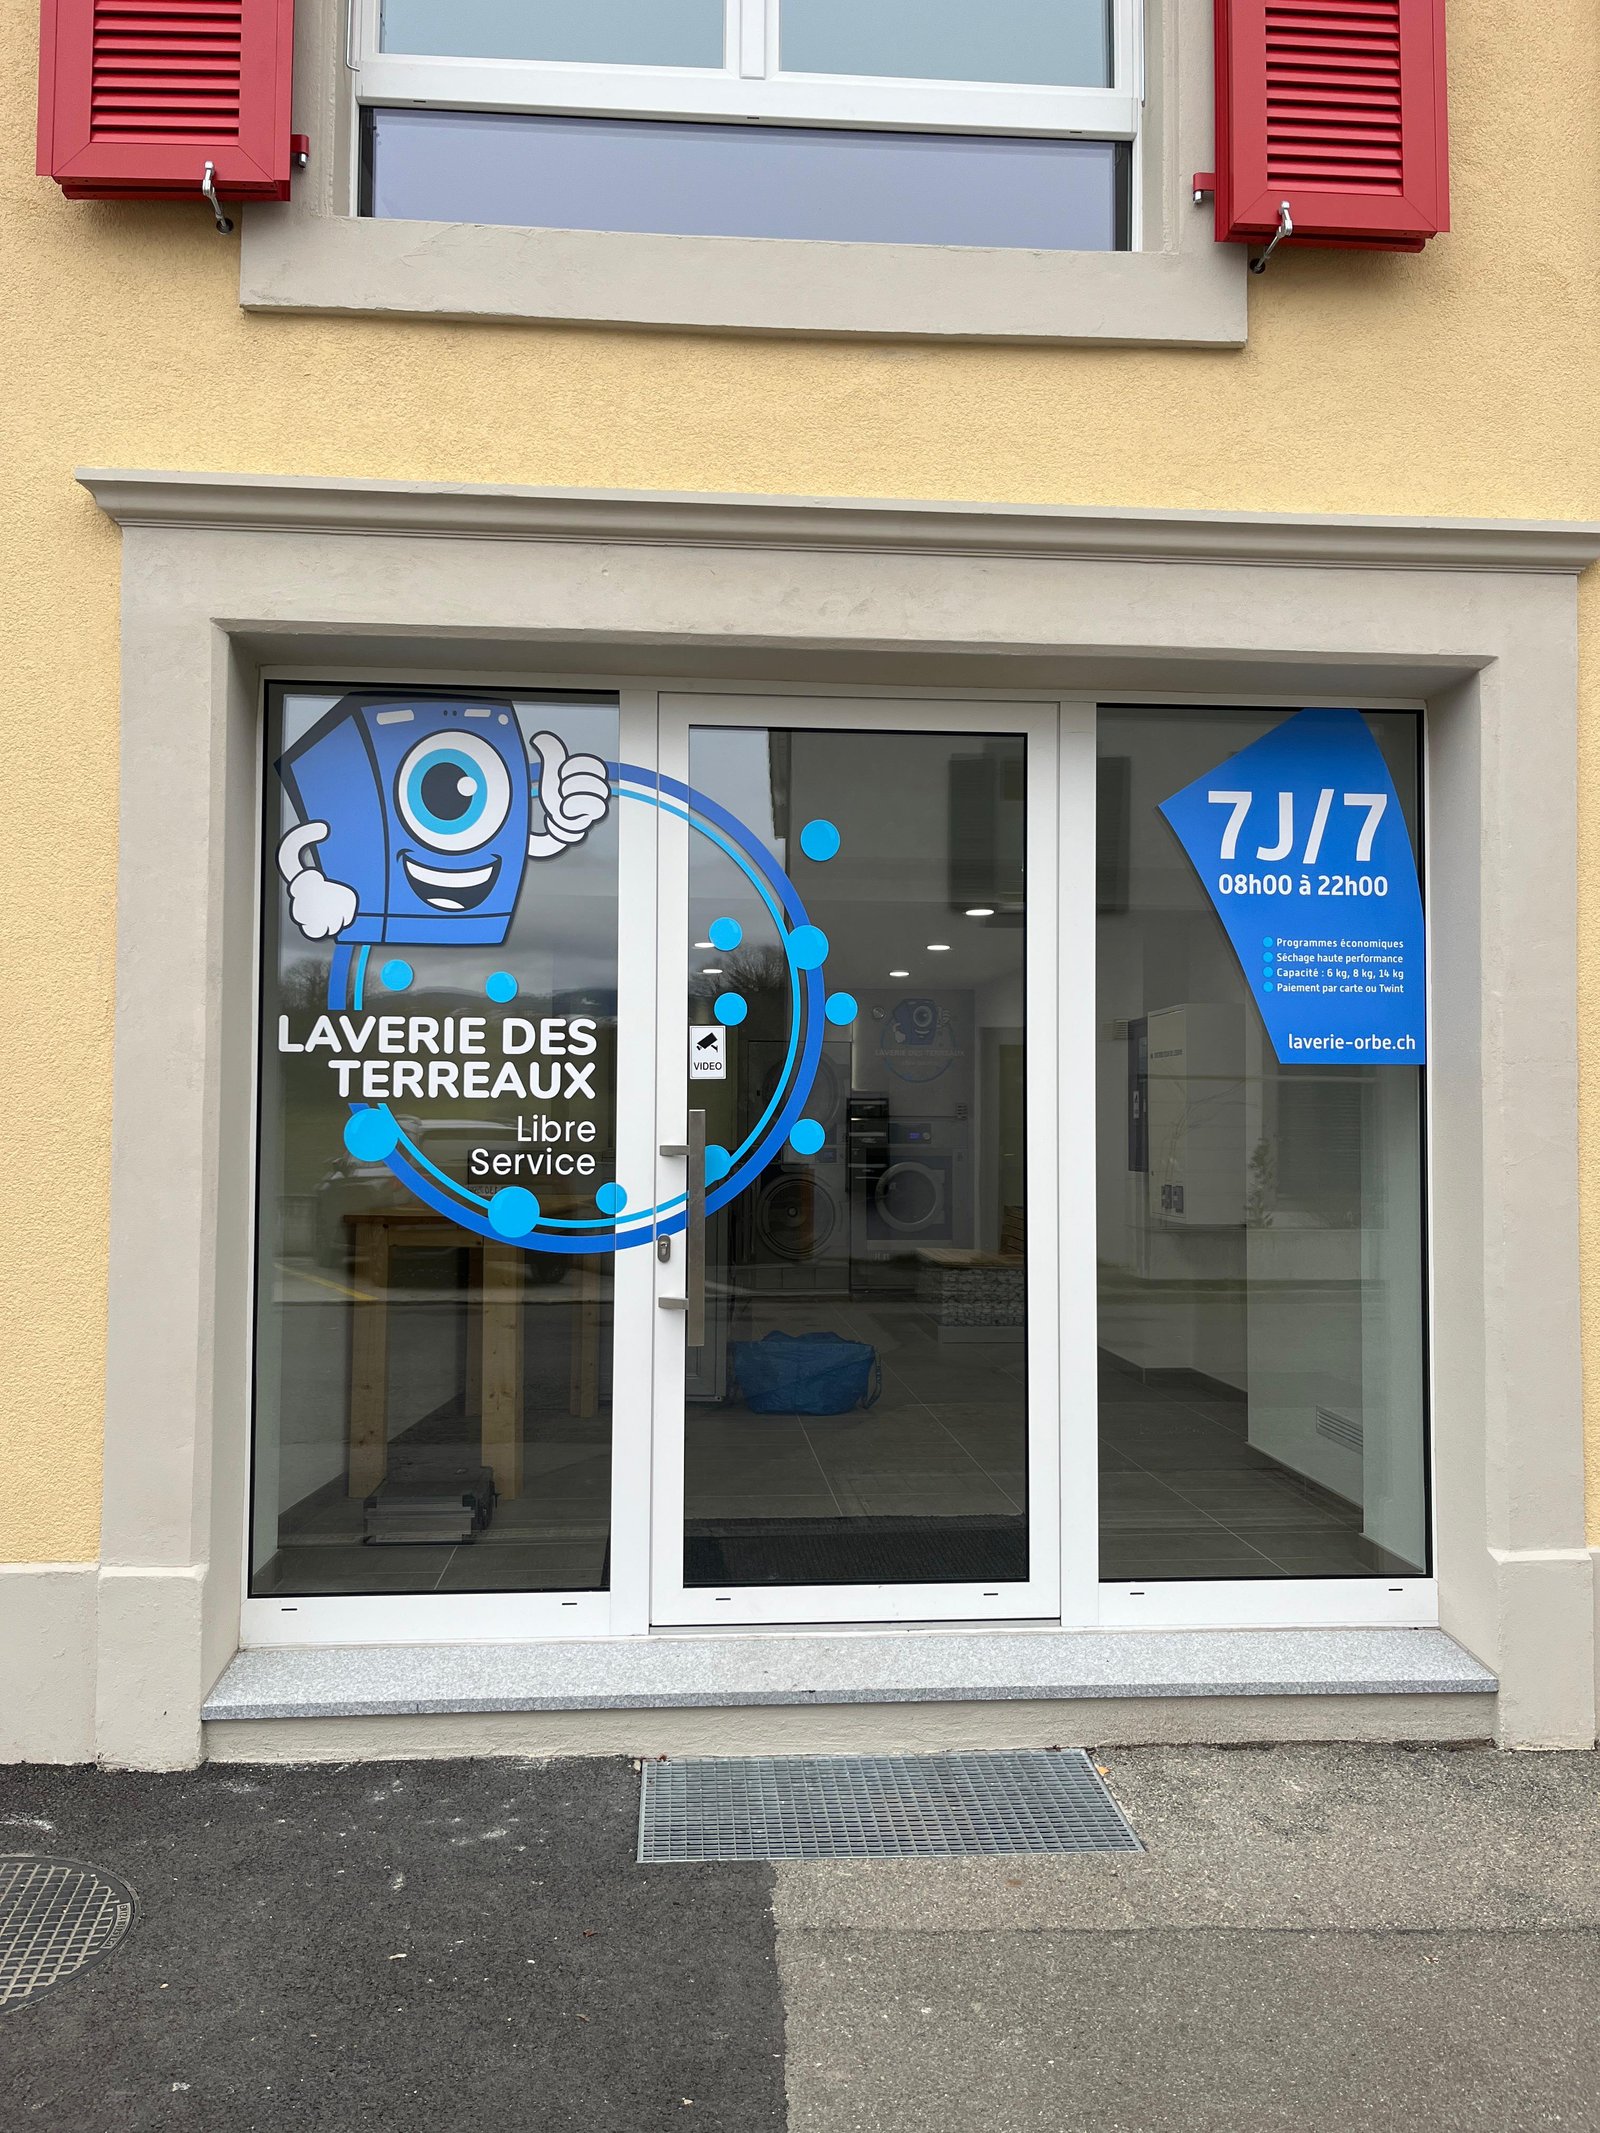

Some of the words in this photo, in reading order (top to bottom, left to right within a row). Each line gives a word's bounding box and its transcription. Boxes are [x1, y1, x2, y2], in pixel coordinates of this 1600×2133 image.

[1208, 788, 1388, 865] 7J/7
[1218, 873, 1293, 896] 08h00
[1299, 874, 1311, 896] à
[1318, 875, 1388, 897] 22h00
[1276, 938, 1338, 949] Programmes
[1340, 938, 1404, 950] économiques
[1276, 952, 1315, 963] Séchage
[1317, 953, 1344, 963] haute
[1345, 953, 1404, 965] performance
[1276, 967, 1319, 979] Capacité
[1326, 969, 1333, 978] 6
[1335, 968, 1350, 979] kg,
[1353, 969, 1359, 978] 8
[1361, 969, 1376, 980] kg,
[1378, 969, 1390, 978] 14
[1392, 969, 1404, 980] kg
[1276, 983, 1321, 993] Paiement
[1322, 985, 1337, 994] par
[1339, 984, 1363, 993] carte
[1365, 985, 1377, 993] ou
[1379, 984, 1404, 993] Twint
[278, 1014, 487, 1054] LAVERIE
[502, 1017, 597, 1056] DES
[1288, 1033, 1416, 1050] laverie-orbe.ch
[693, 1061, 723, 1071] VIDEO
[328, 1060, 596, 1099] TERREAUX
[517, 1114, 596, 1143] Libre
[470, 1147, 596, 1176] Service
